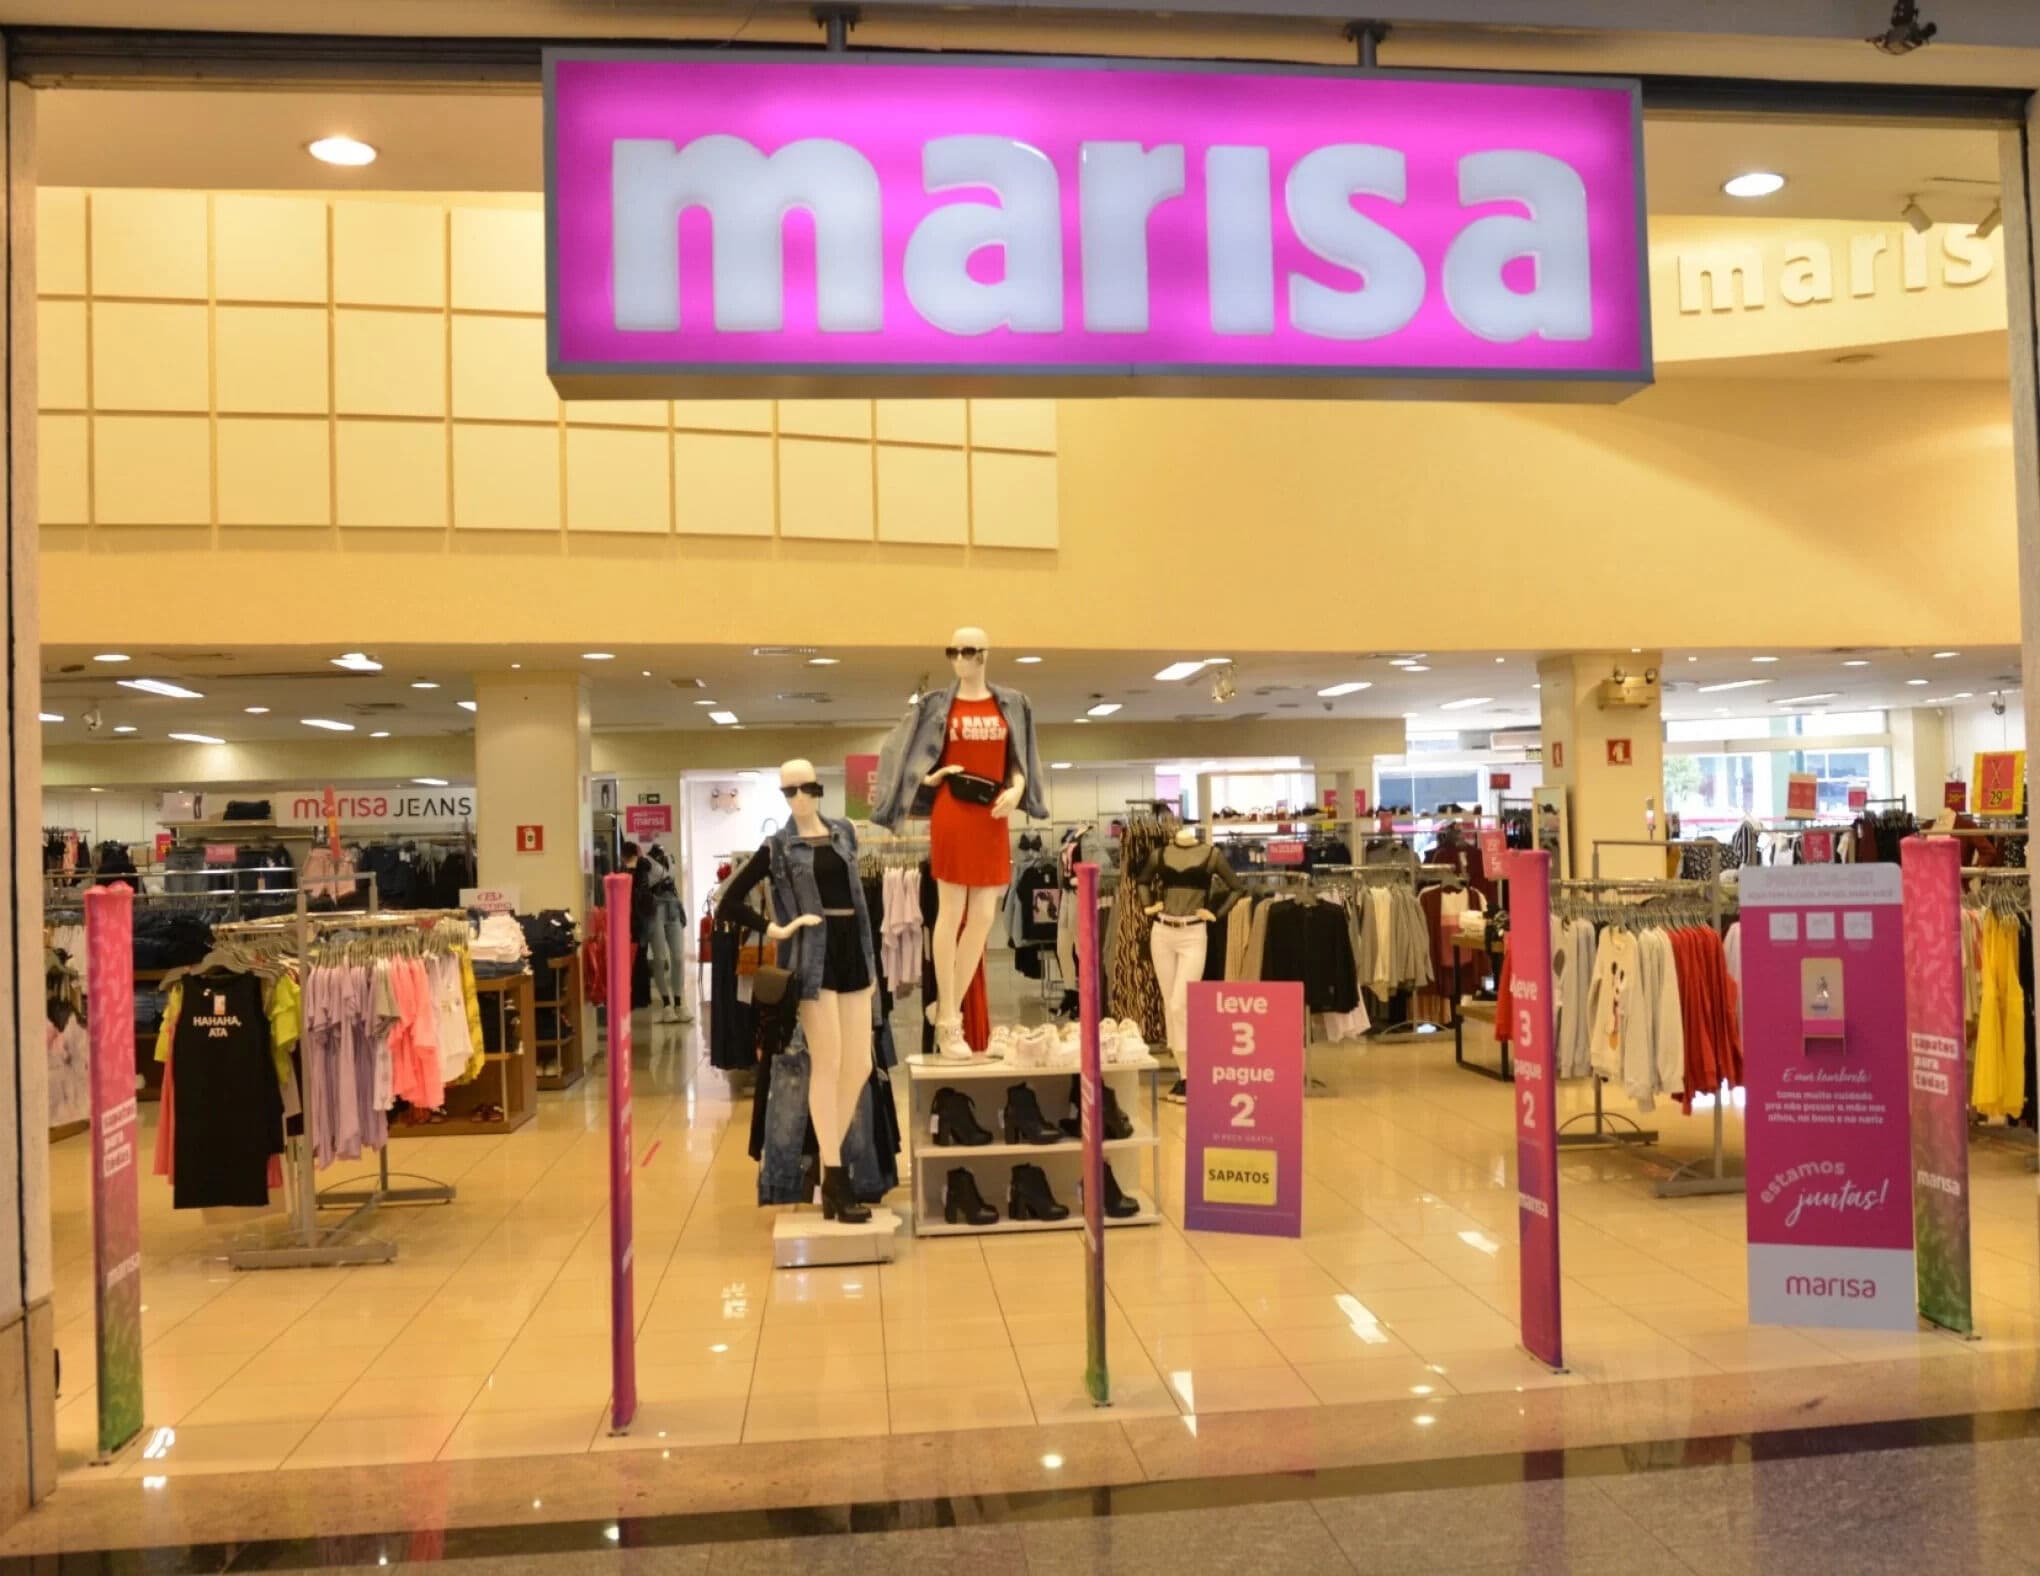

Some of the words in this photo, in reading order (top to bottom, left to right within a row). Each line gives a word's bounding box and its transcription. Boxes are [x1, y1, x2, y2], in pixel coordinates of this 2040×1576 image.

[612, 134, 1593, 342] marisa
[393, 797, 472, 817] JEANS
[1509, 974, 1538, 1000] leve
[1216, 991, 1268, 1015] leve
[208, 1027, 228, 1038] ATA
[1231, 1022, 1256, 1057] 3
[1519, 1009, 1533, 1047] 3
[1211, 1066, 1275, 1085] pague
[1522, 1091, 1536, 1129] 2
[1208, 1169, 1270, 1185] SAPATOS
[1760, 1160, 1846, 1204] estamos
[1917, 1169, 1961, 1197] marisa
[1785, 1178, 1890, 1228] juntas!
[1786, 1275, 1877, 1299] marisa
